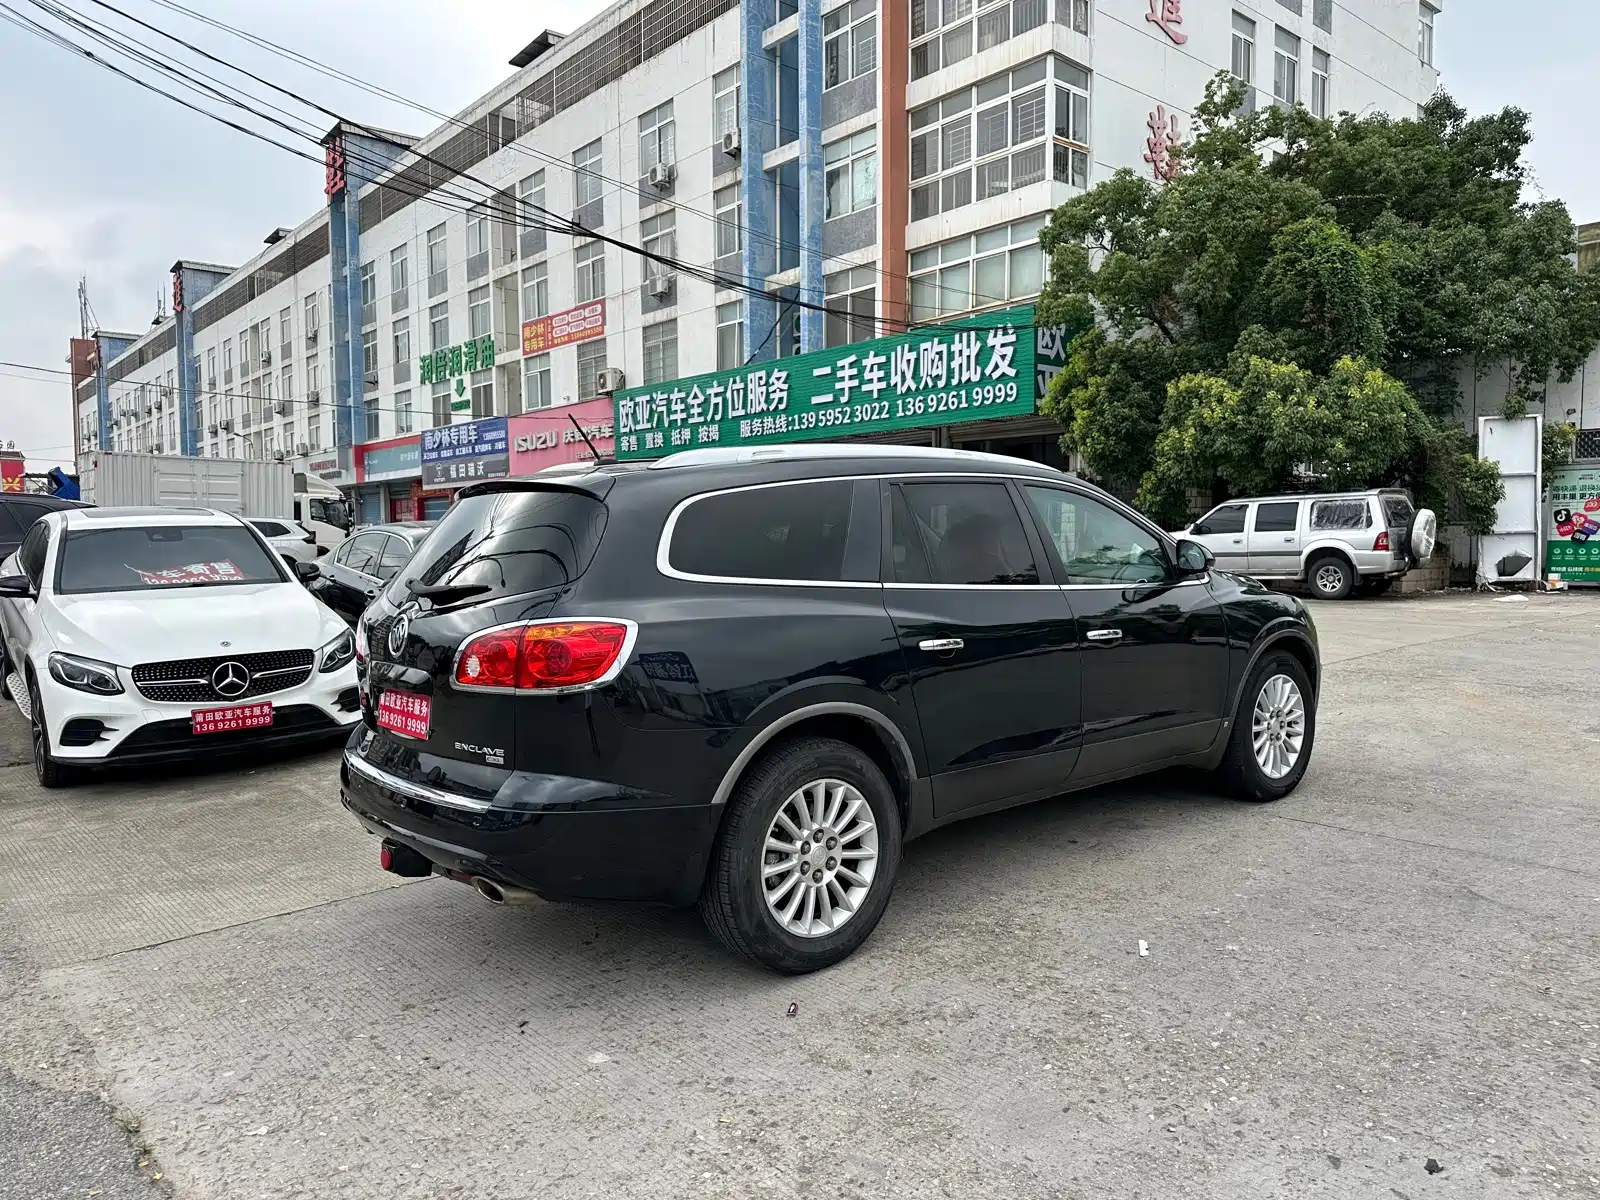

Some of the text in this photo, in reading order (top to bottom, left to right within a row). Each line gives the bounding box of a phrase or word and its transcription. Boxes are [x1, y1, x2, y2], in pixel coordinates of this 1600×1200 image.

[619, 324, 1018, 434] 欧亚汽车全方位服务 二手车收购批发
[620, 435, 639, 452] 寄售
[645, 431, 665, 449] 置换
[671, 427, 692, 446] 抵押
[698, 424, 720, 443] 按揭
[818, 406, 851, 428] 5952
[854, 401, 890, 423] 3022
[896, 395, 925, 418] 136
[927, 388, 969, 412] 9261
[972, 382, 1018, 407] 9999
[424, 424, 478, 451] 南少林专用车
[514, 428, 559, 453] ISUZU
[449, 461, 485, 479] 福田瑞沃
[195, 705, 271, 723] 莆田欧亚汽车服务
[380, 691, 428, 717] 莆田欧亚汽车服务
[195, 715, 271, 732] 136 9261 9999
[379, 709, 427, 735] 136 9261 9999
[455, 741, 505, 757] ENCLAVE
